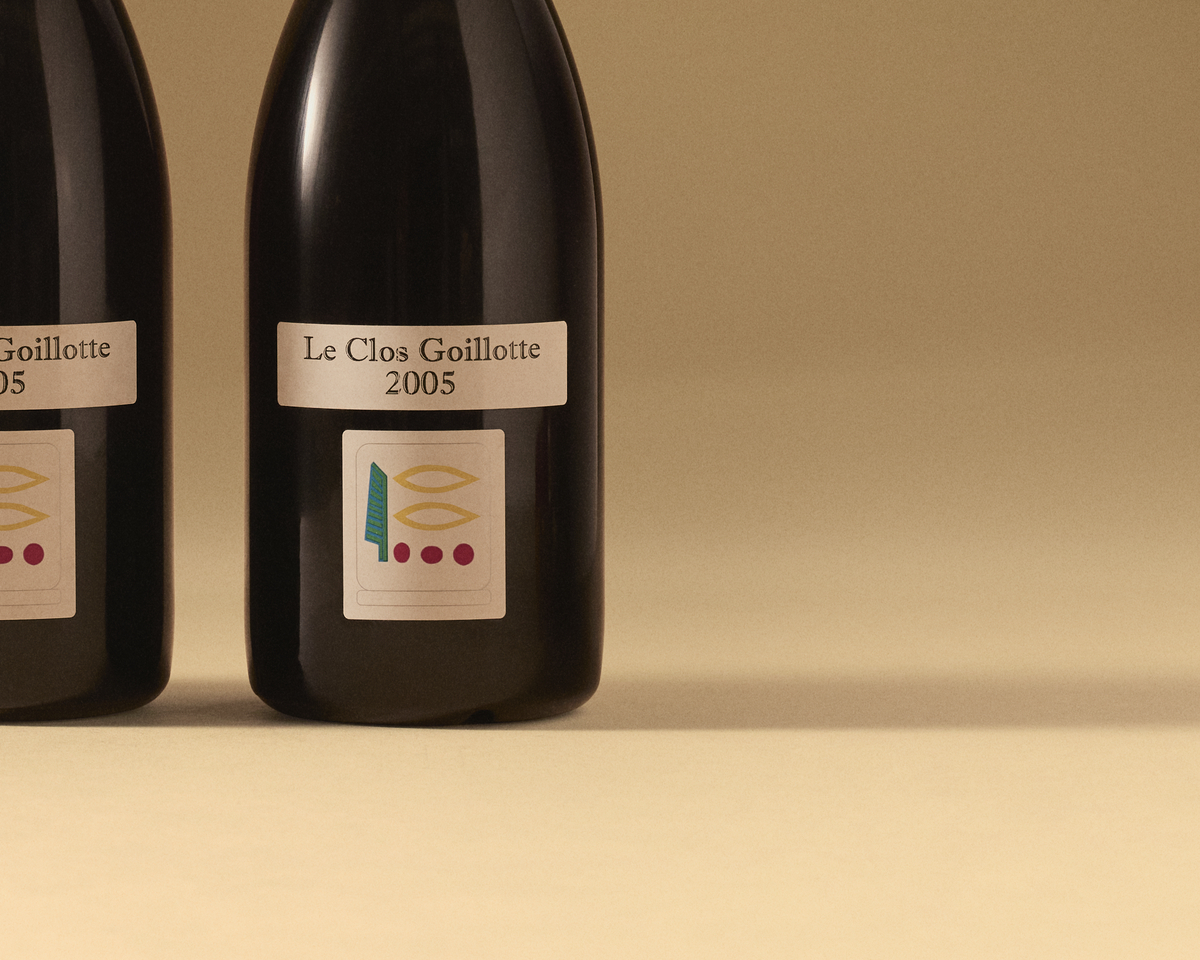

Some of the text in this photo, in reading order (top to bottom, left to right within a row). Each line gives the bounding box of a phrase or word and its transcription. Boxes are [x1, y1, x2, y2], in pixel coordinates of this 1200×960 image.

[303, 336, 541, 362] Le Clos Goillotte
[385, 371, 456, 396] 2005
